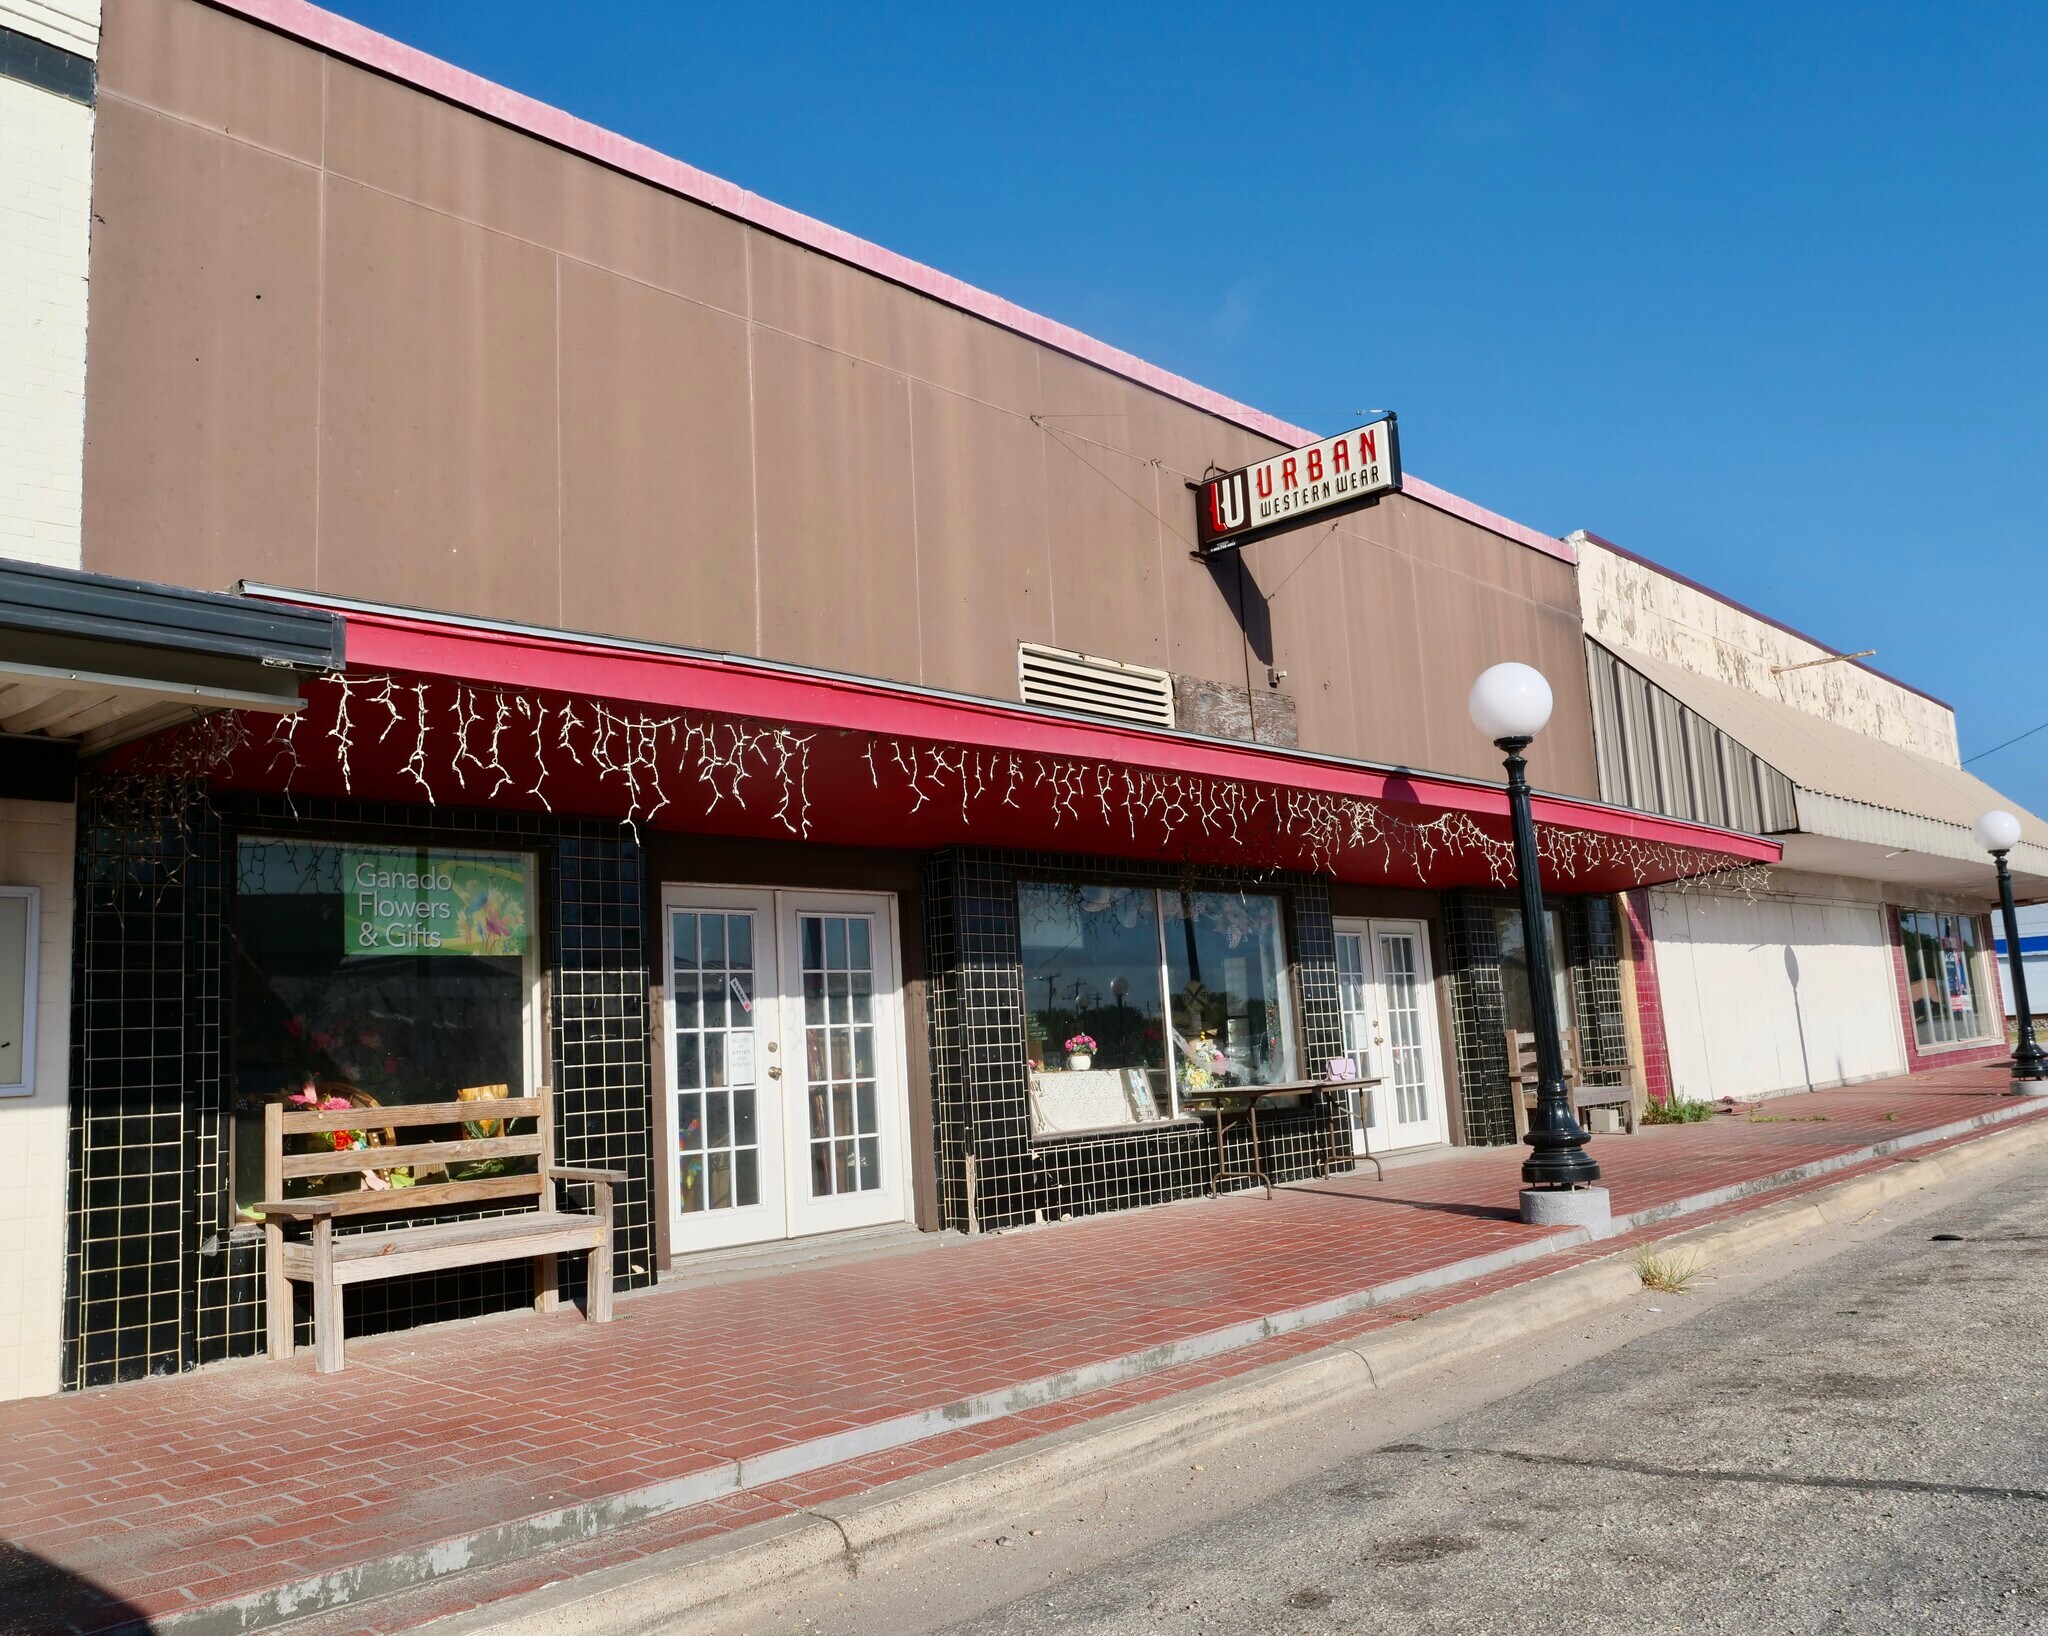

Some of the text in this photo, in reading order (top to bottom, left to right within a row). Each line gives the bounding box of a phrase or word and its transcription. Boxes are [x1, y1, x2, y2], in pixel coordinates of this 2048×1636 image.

[1256, 429, 1377, 498] URBAN
[1260, 465, 1380, 518] WESTERN WEAR
[355, 862, 453, 891] Ganado
[358, 891, 451, 919] Flowers
[358, 921, 443, 948] & Gifts
